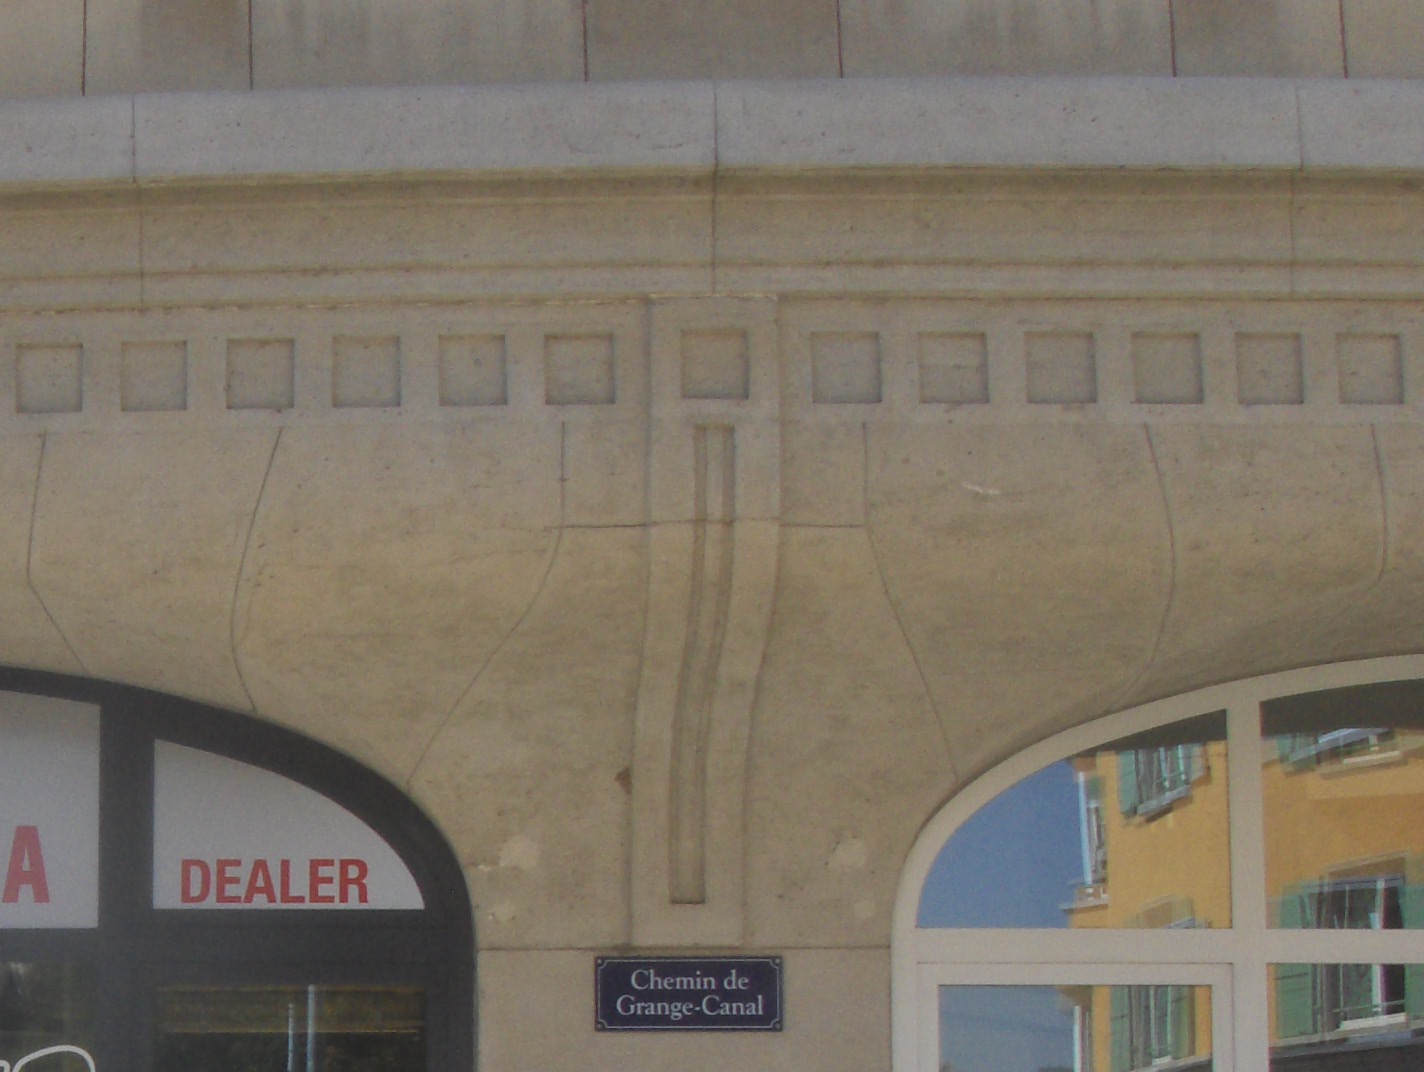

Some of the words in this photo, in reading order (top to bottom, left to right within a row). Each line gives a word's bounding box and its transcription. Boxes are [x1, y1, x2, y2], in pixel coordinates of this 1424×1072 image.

[180, 858, 369, 904] DEALER
[631, 969, 716, 990] Chemin
[723, 969, 749, 990] de
[616, 994, 763, 1021] Grange-Canal
